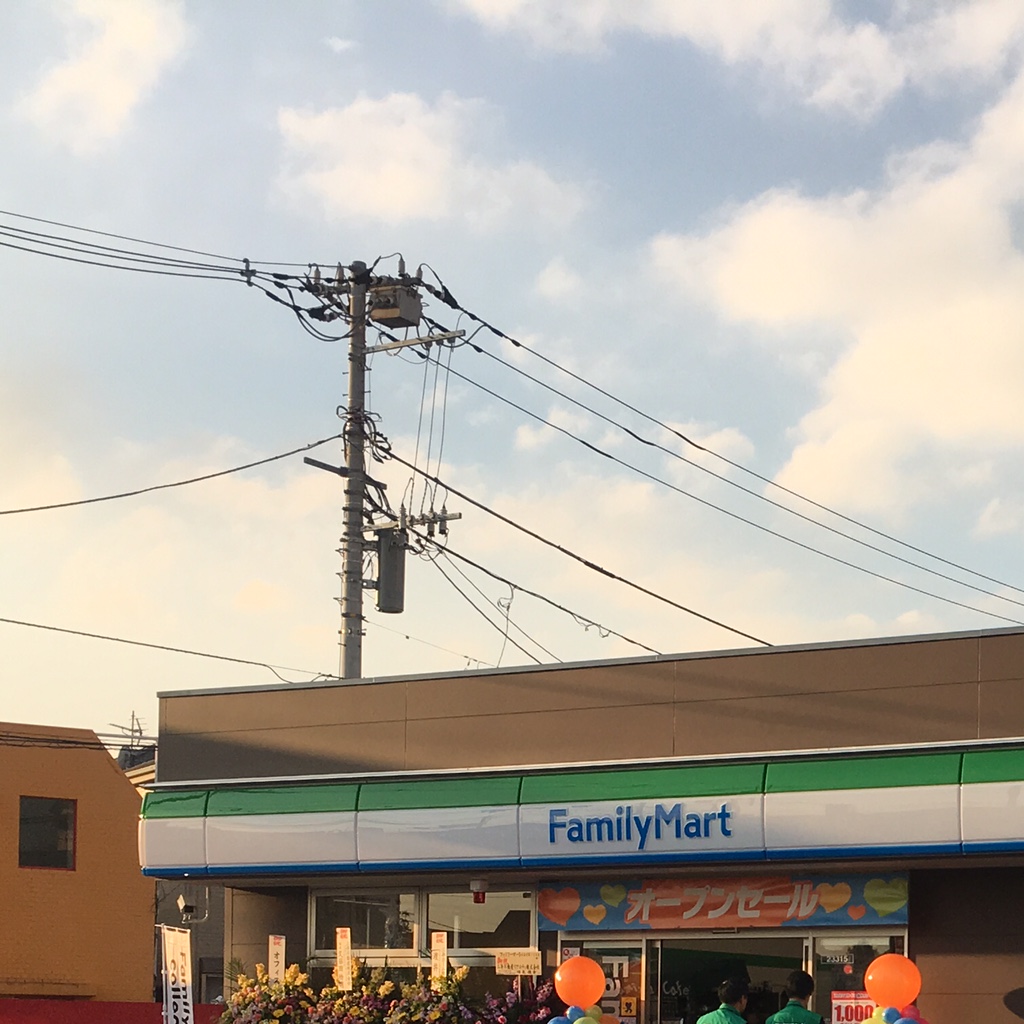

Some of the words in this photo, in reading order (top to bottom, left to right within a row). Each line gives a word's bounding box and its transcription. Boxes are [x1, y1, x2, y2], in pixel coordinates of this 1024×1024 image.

[549, 802, 732, 850] FamilyMart
[627, 884, 819, 921] オープンセール
